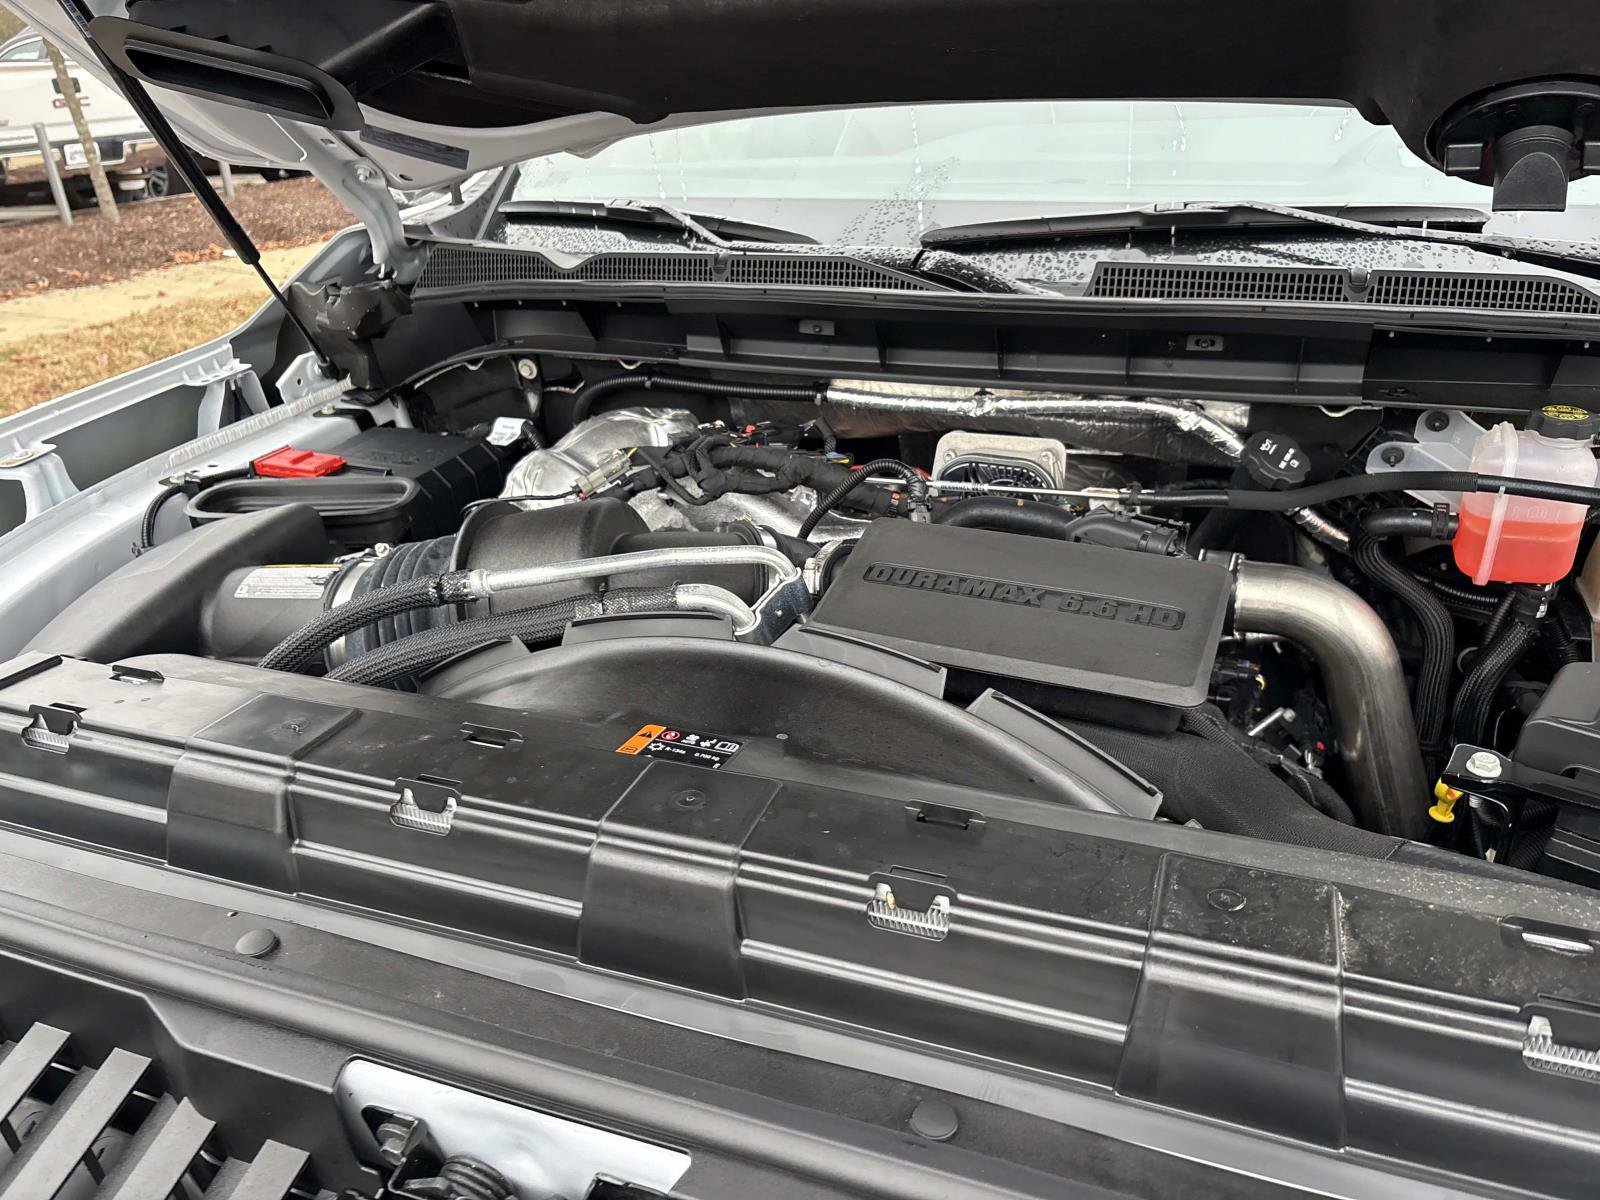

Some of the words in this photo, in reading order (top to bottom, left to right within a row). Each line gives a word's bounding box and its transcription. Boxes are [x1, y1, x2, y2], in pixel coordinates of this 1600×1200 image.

[868, 564, 1046, 607] DURAMAX
[1057, 593, 1119, 620] 6.6
[1124, 605, 1183, 629] HD
